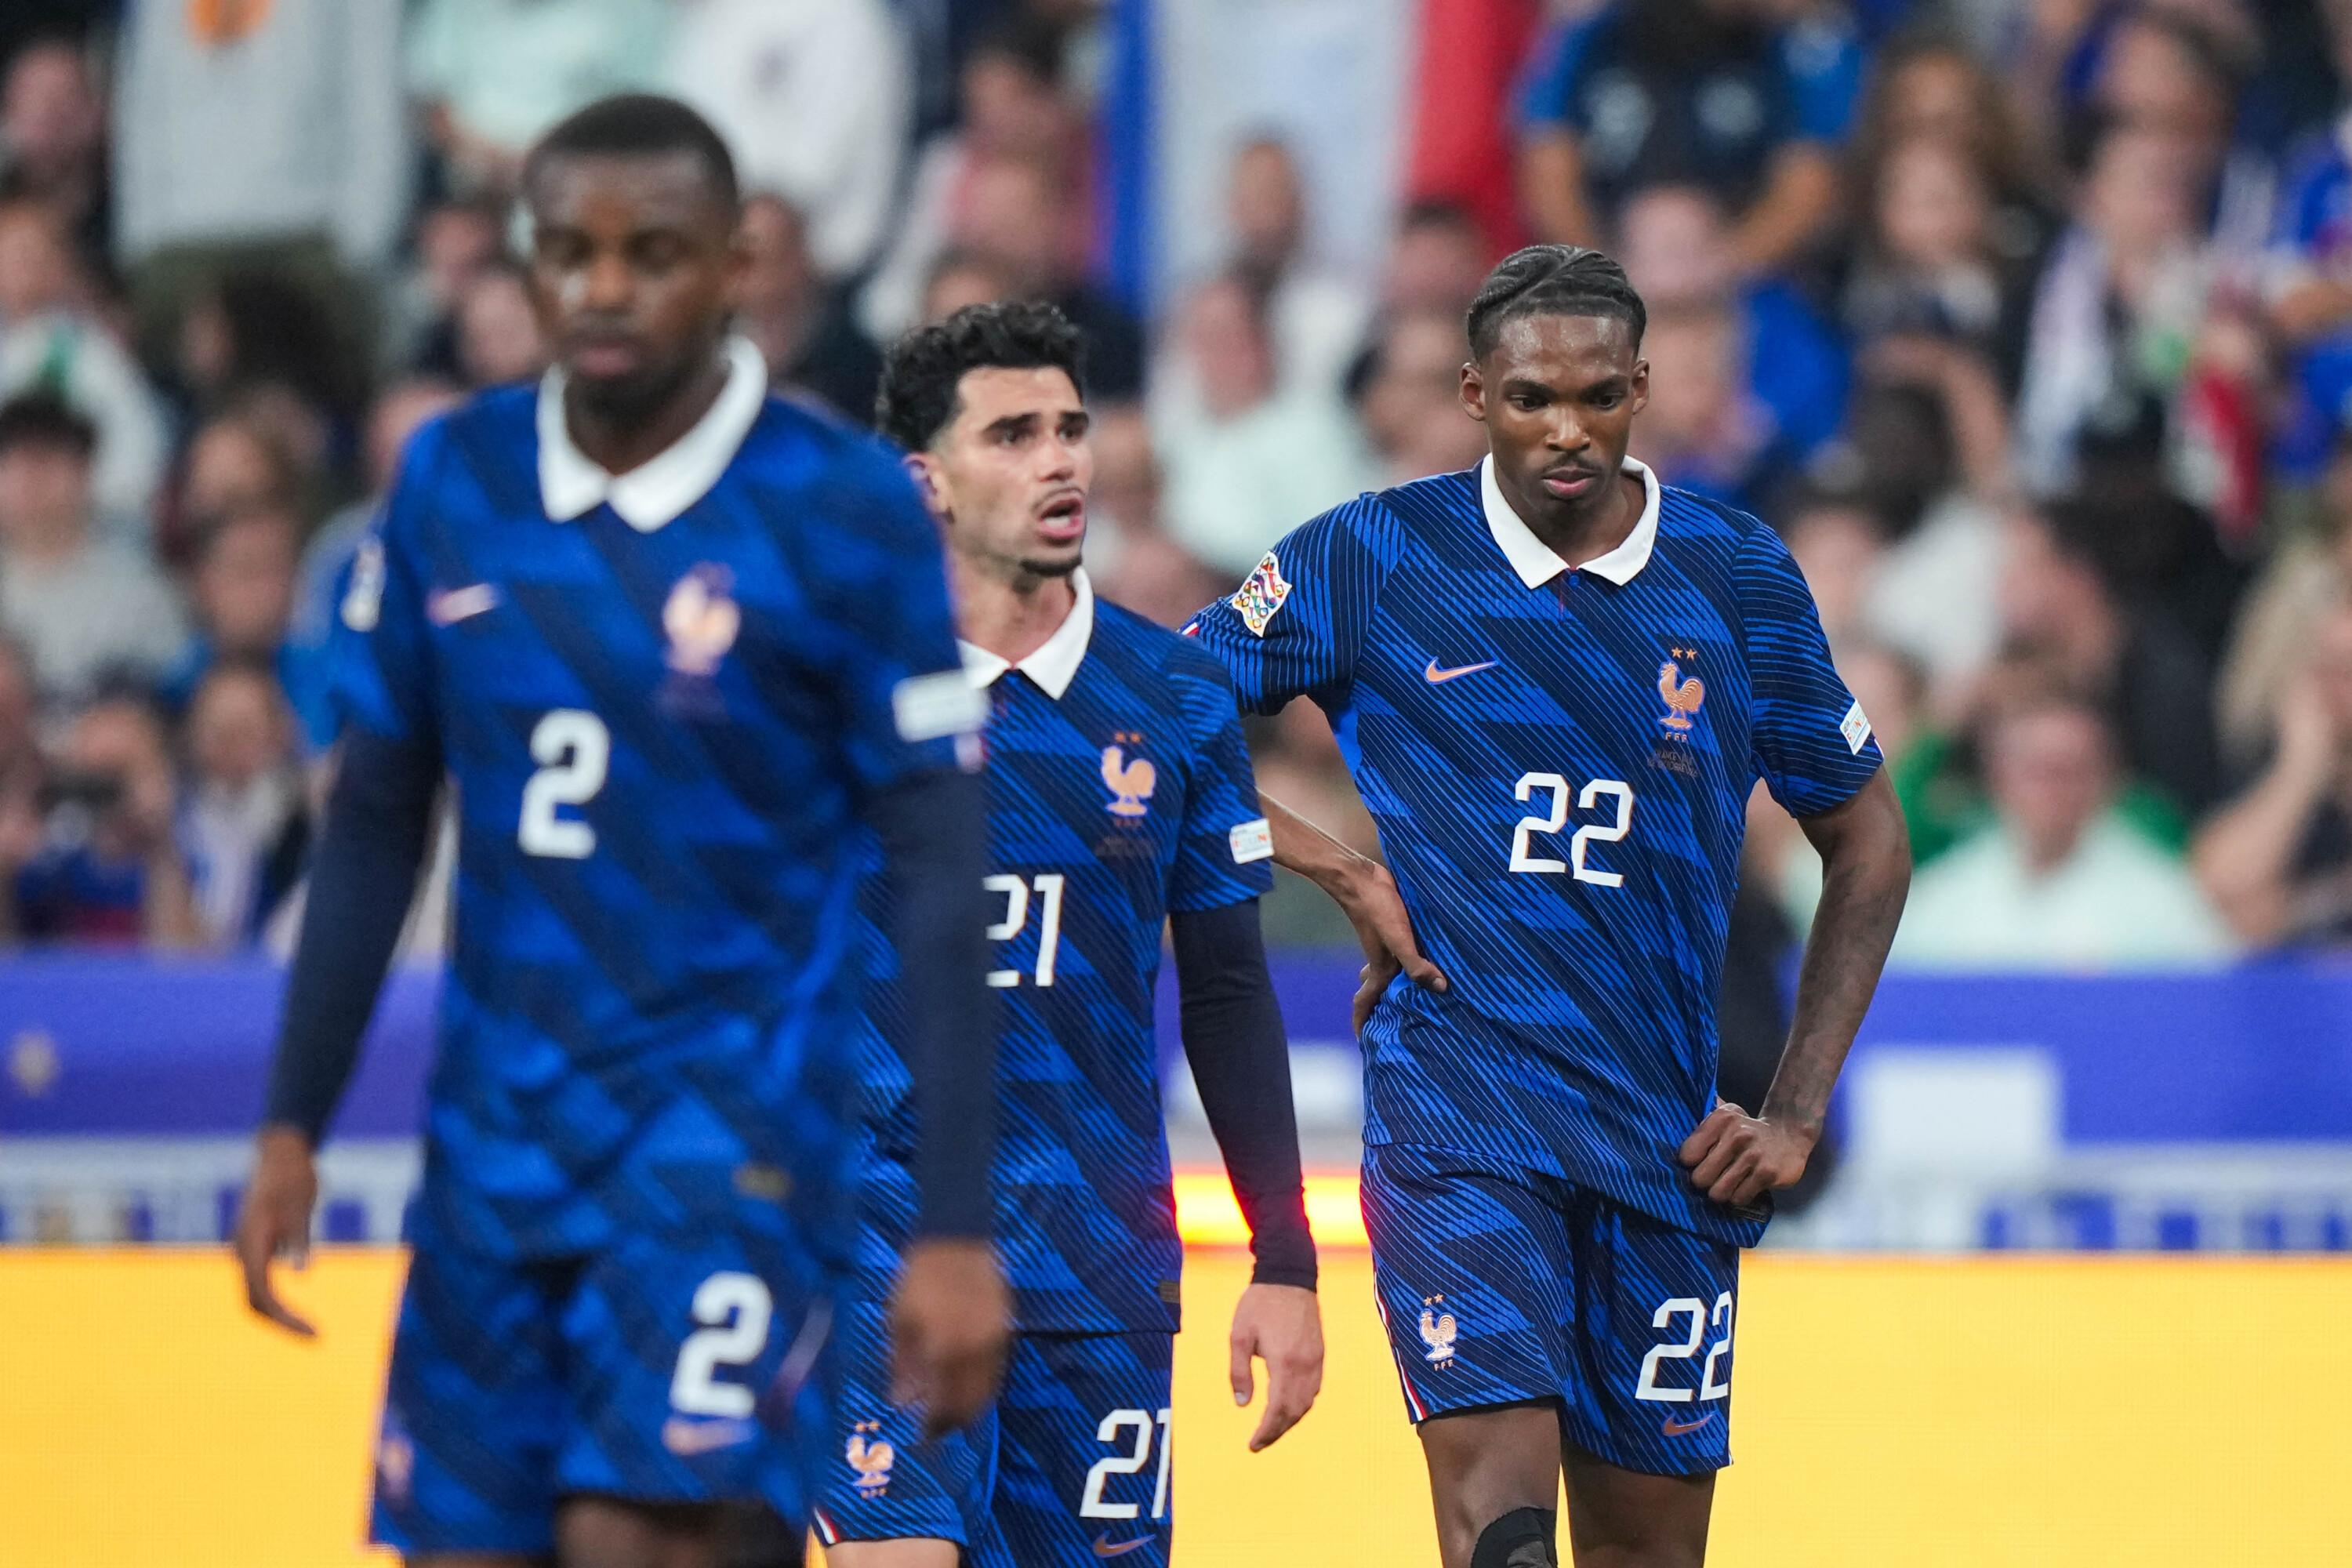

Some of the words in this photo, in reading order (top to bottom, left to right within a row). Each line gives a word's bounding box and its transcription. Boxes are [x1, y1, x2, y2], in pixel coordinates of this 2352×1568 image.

[519, 710, 610, 858] 2
[1508, 771, 1635, 888] 22
[982, 873, 1065, 988] 21
[671, 1270, 772, 1420] 2
[1635, 1290, 1733, 1402] 22
[1079, 1407, 1171, 1519] 21
